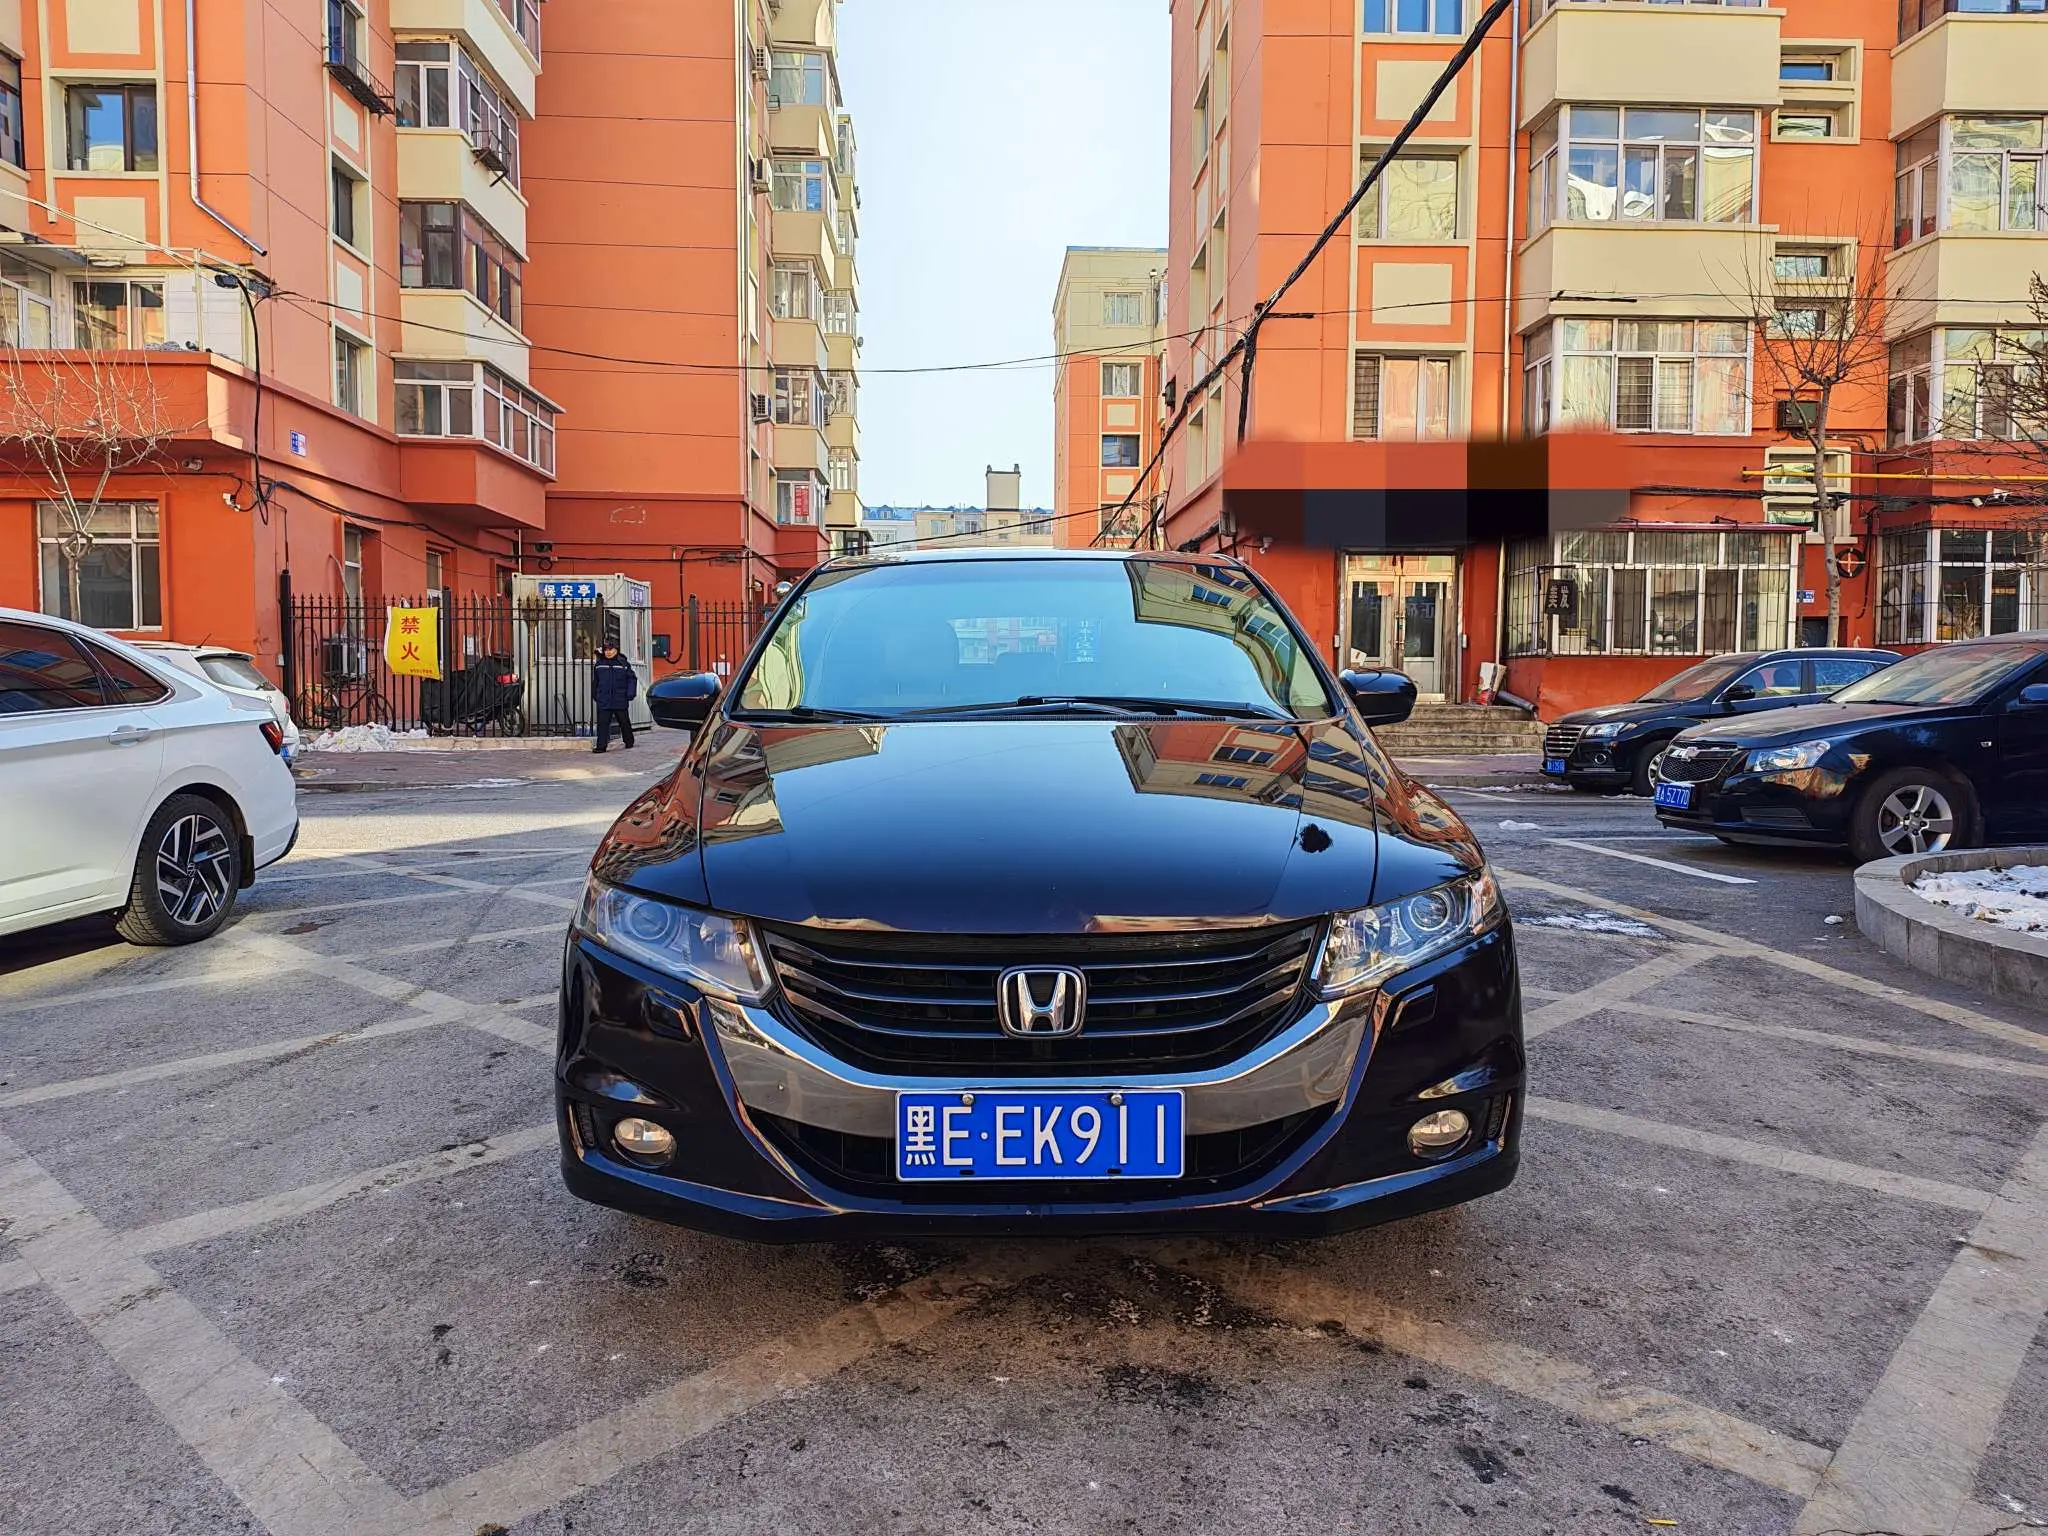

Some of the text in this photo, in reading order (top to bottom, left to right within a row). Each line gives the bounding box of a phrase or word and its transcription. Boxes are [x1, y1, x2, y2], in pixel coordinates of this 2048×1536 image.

[544, 584, 591, 597] 保安亭
[401, 616, 420, 661] 禁火
